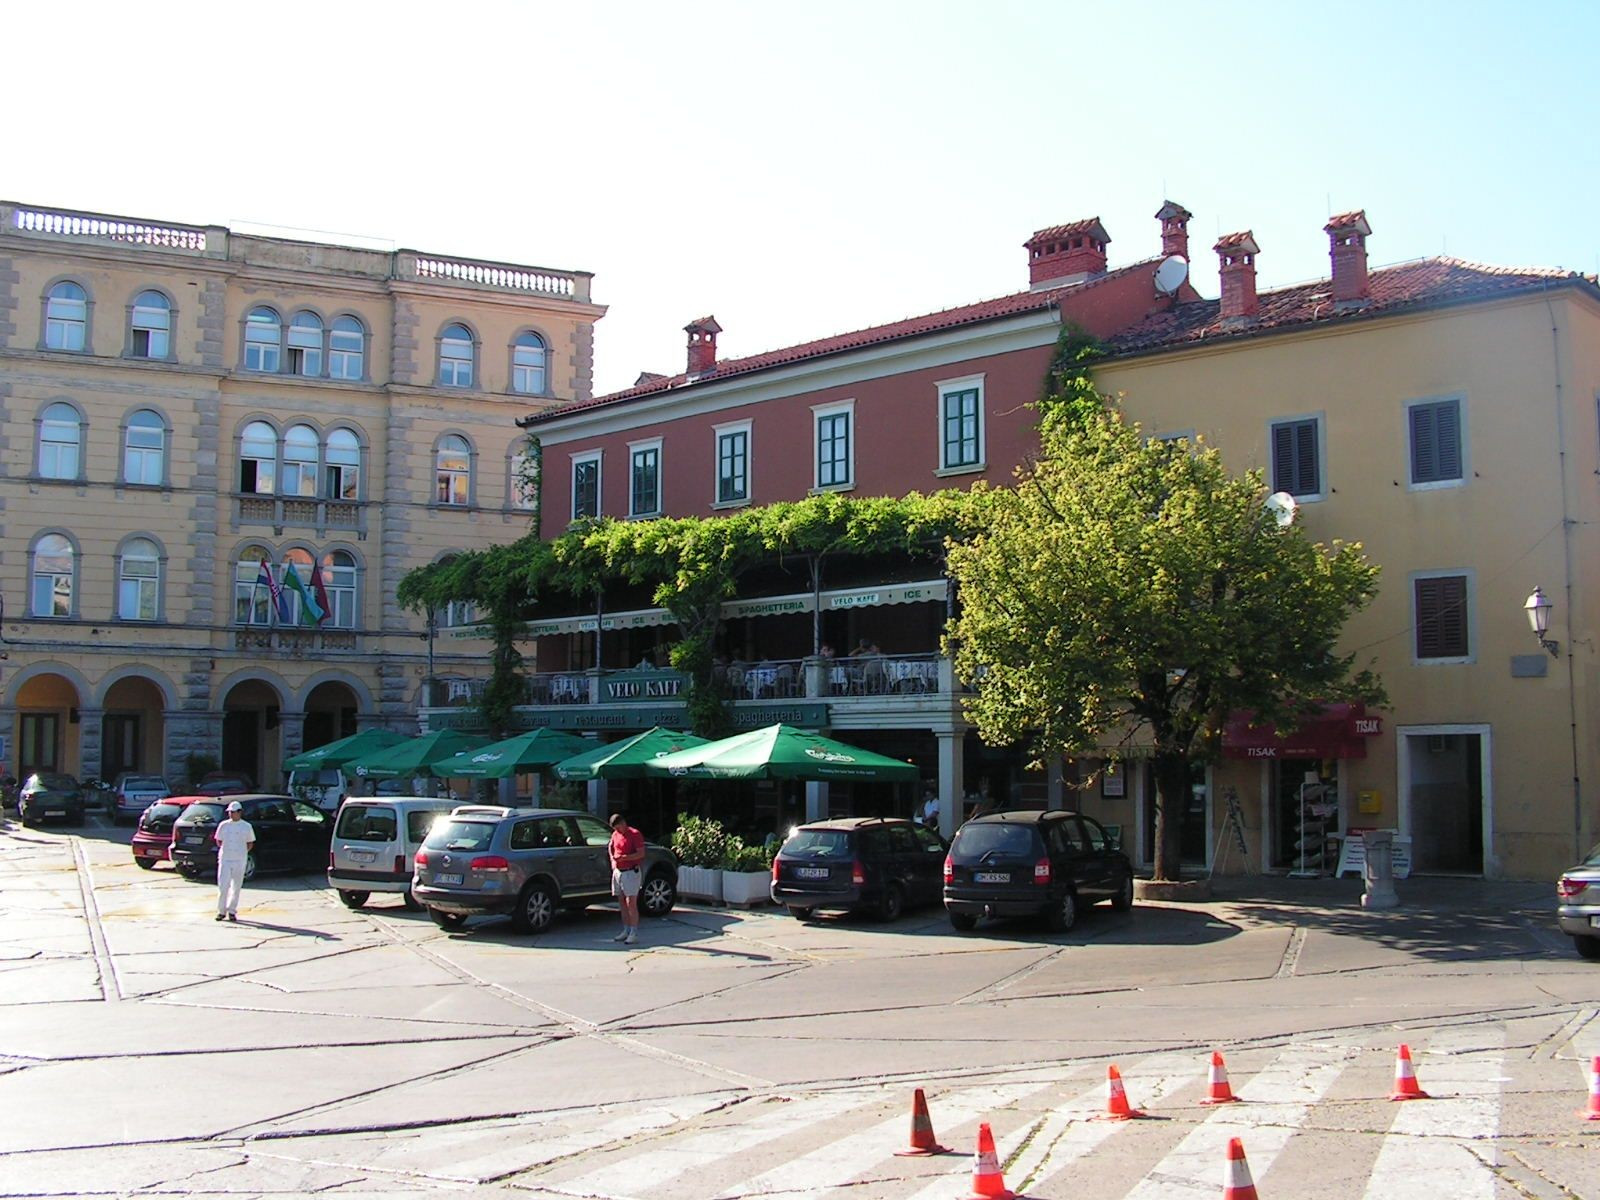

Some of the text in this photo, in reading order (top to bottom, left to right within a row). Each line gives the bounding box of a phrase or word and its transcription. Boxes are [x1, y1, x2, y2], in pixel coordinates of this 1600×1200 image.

[738, 591, 922, 615] SPAGHETTERIA VELO KAFE ICE
[631, 616, 645, 624] ICE
[608, 680, 682, 697] VELO KAFE
[575, 713, 626, 726] restaurant
[733, 709, 802, 725] spaghetteria
[1354, 719, 1379, 734] TISAK
[1247, 748, 1277, 757] TISAK
